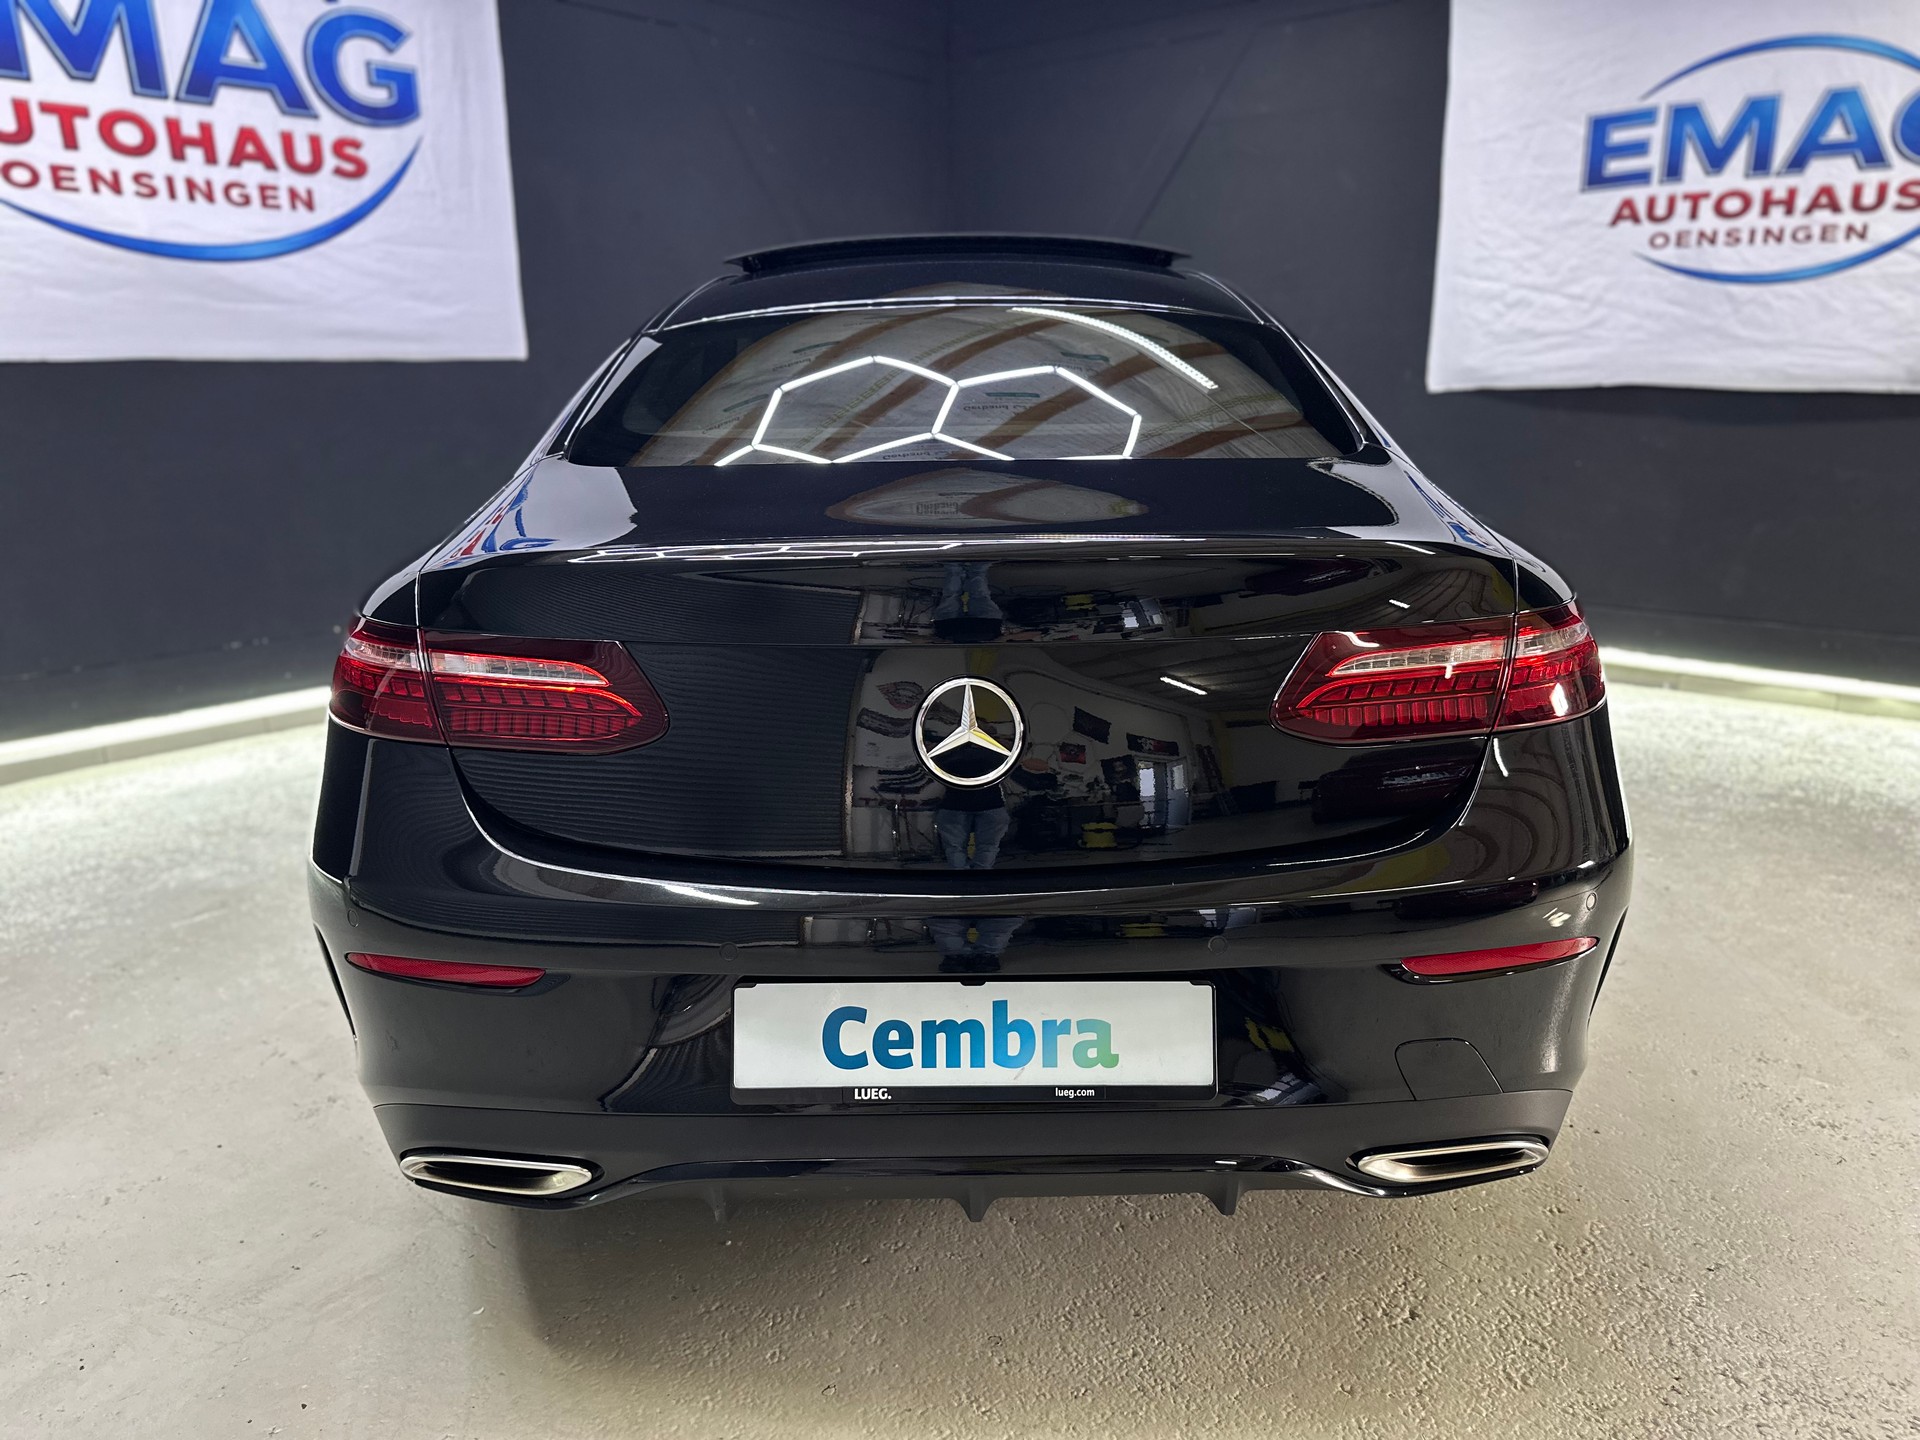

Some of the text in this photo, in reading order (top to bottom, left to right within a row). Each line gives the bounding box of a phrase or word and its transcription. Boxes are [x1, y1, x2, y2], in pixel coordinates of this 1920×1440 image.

[1, 160, 316, 213] OENSINGEN
[1608, 179, 1920, 227] AUTOHAUS
[1648, 222, 1869, 250] OENSINGEN
[822, 999, 1119, 1070] Cembra
[854, 1088, 892, 1100] LUEG.
[1055, 1087, 1095, 1098] lueg.com
